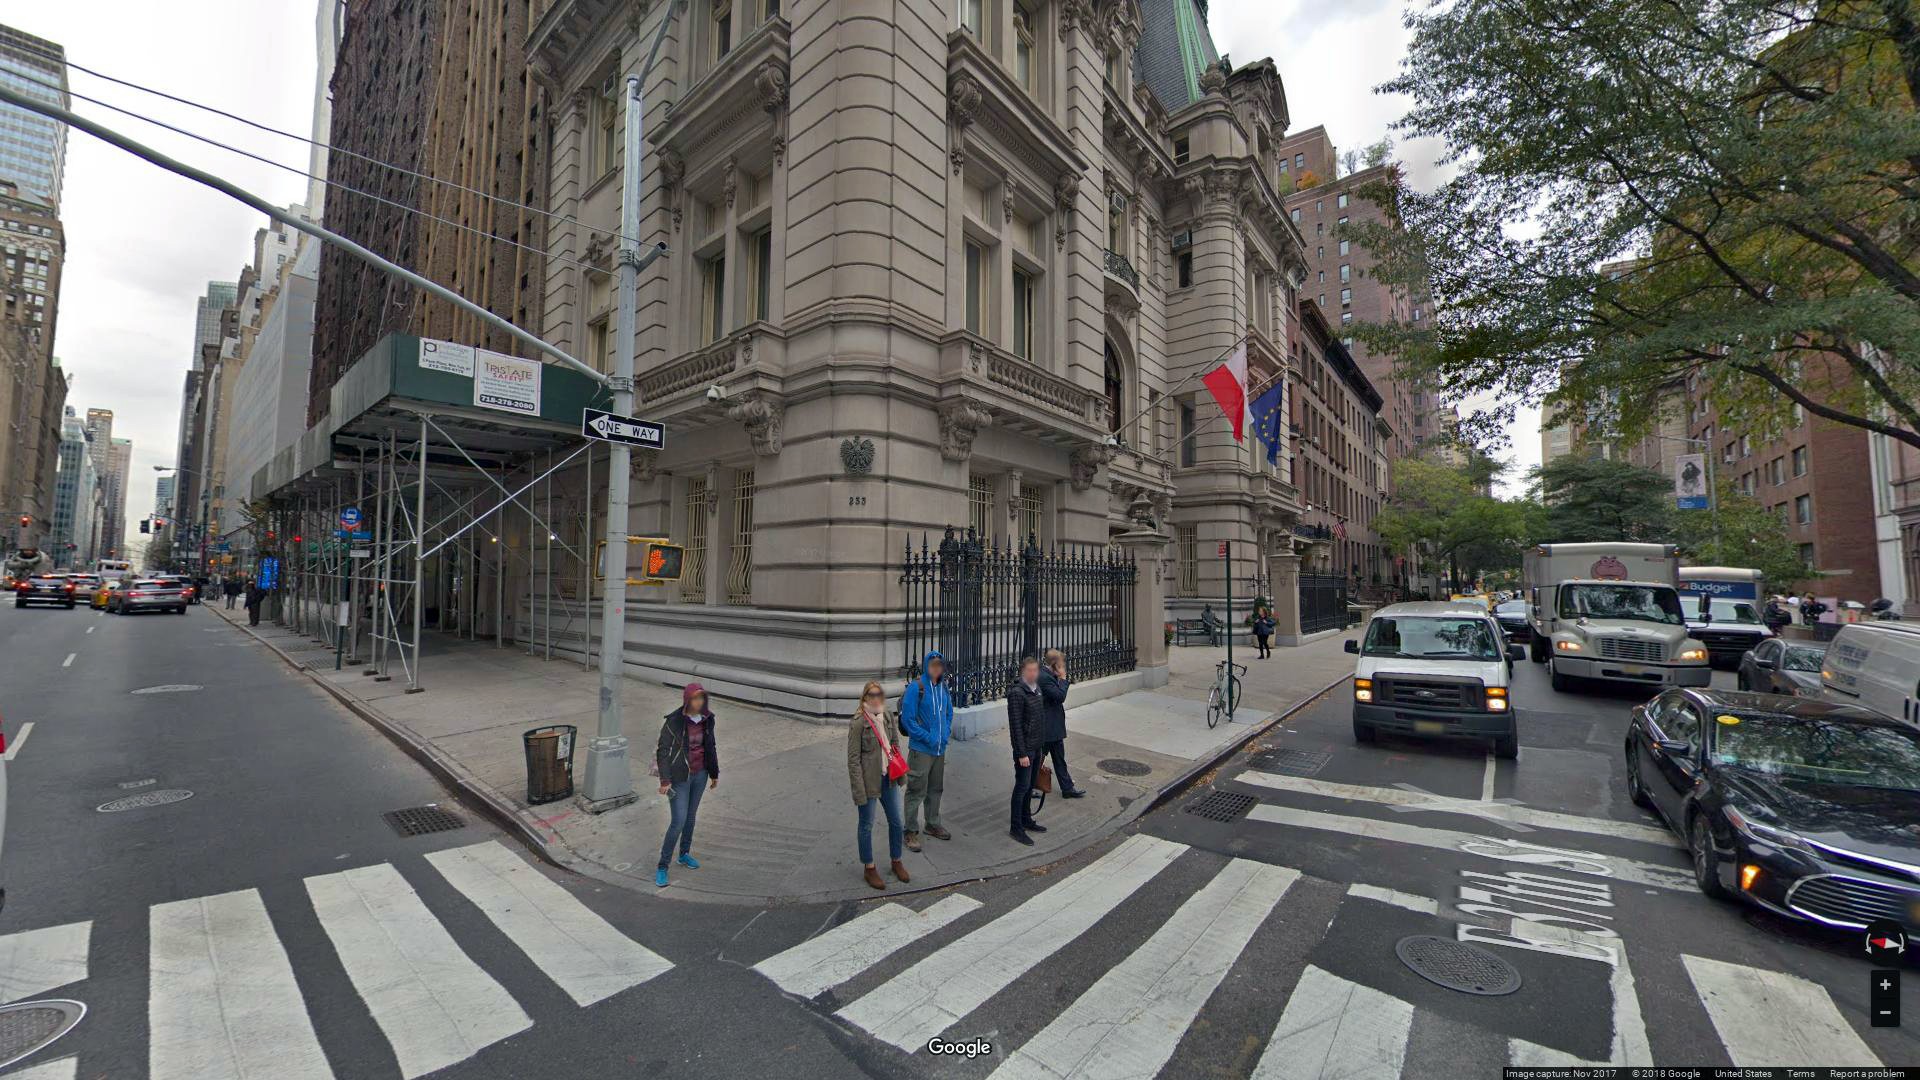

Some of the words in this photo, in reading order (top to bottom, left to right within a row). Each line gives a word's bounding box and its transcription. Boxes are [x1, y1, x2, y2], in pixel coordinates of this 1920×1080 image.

[485, 362, 533, 380] TRISTATE
[493, 372, 523, 383] SAFETY
[597, 420, 621, 434] ONE
[632, 427, 655, 440] WAY
[848, 496, 866, 506] 233
[1690, 582, 1733, 594] Budget
